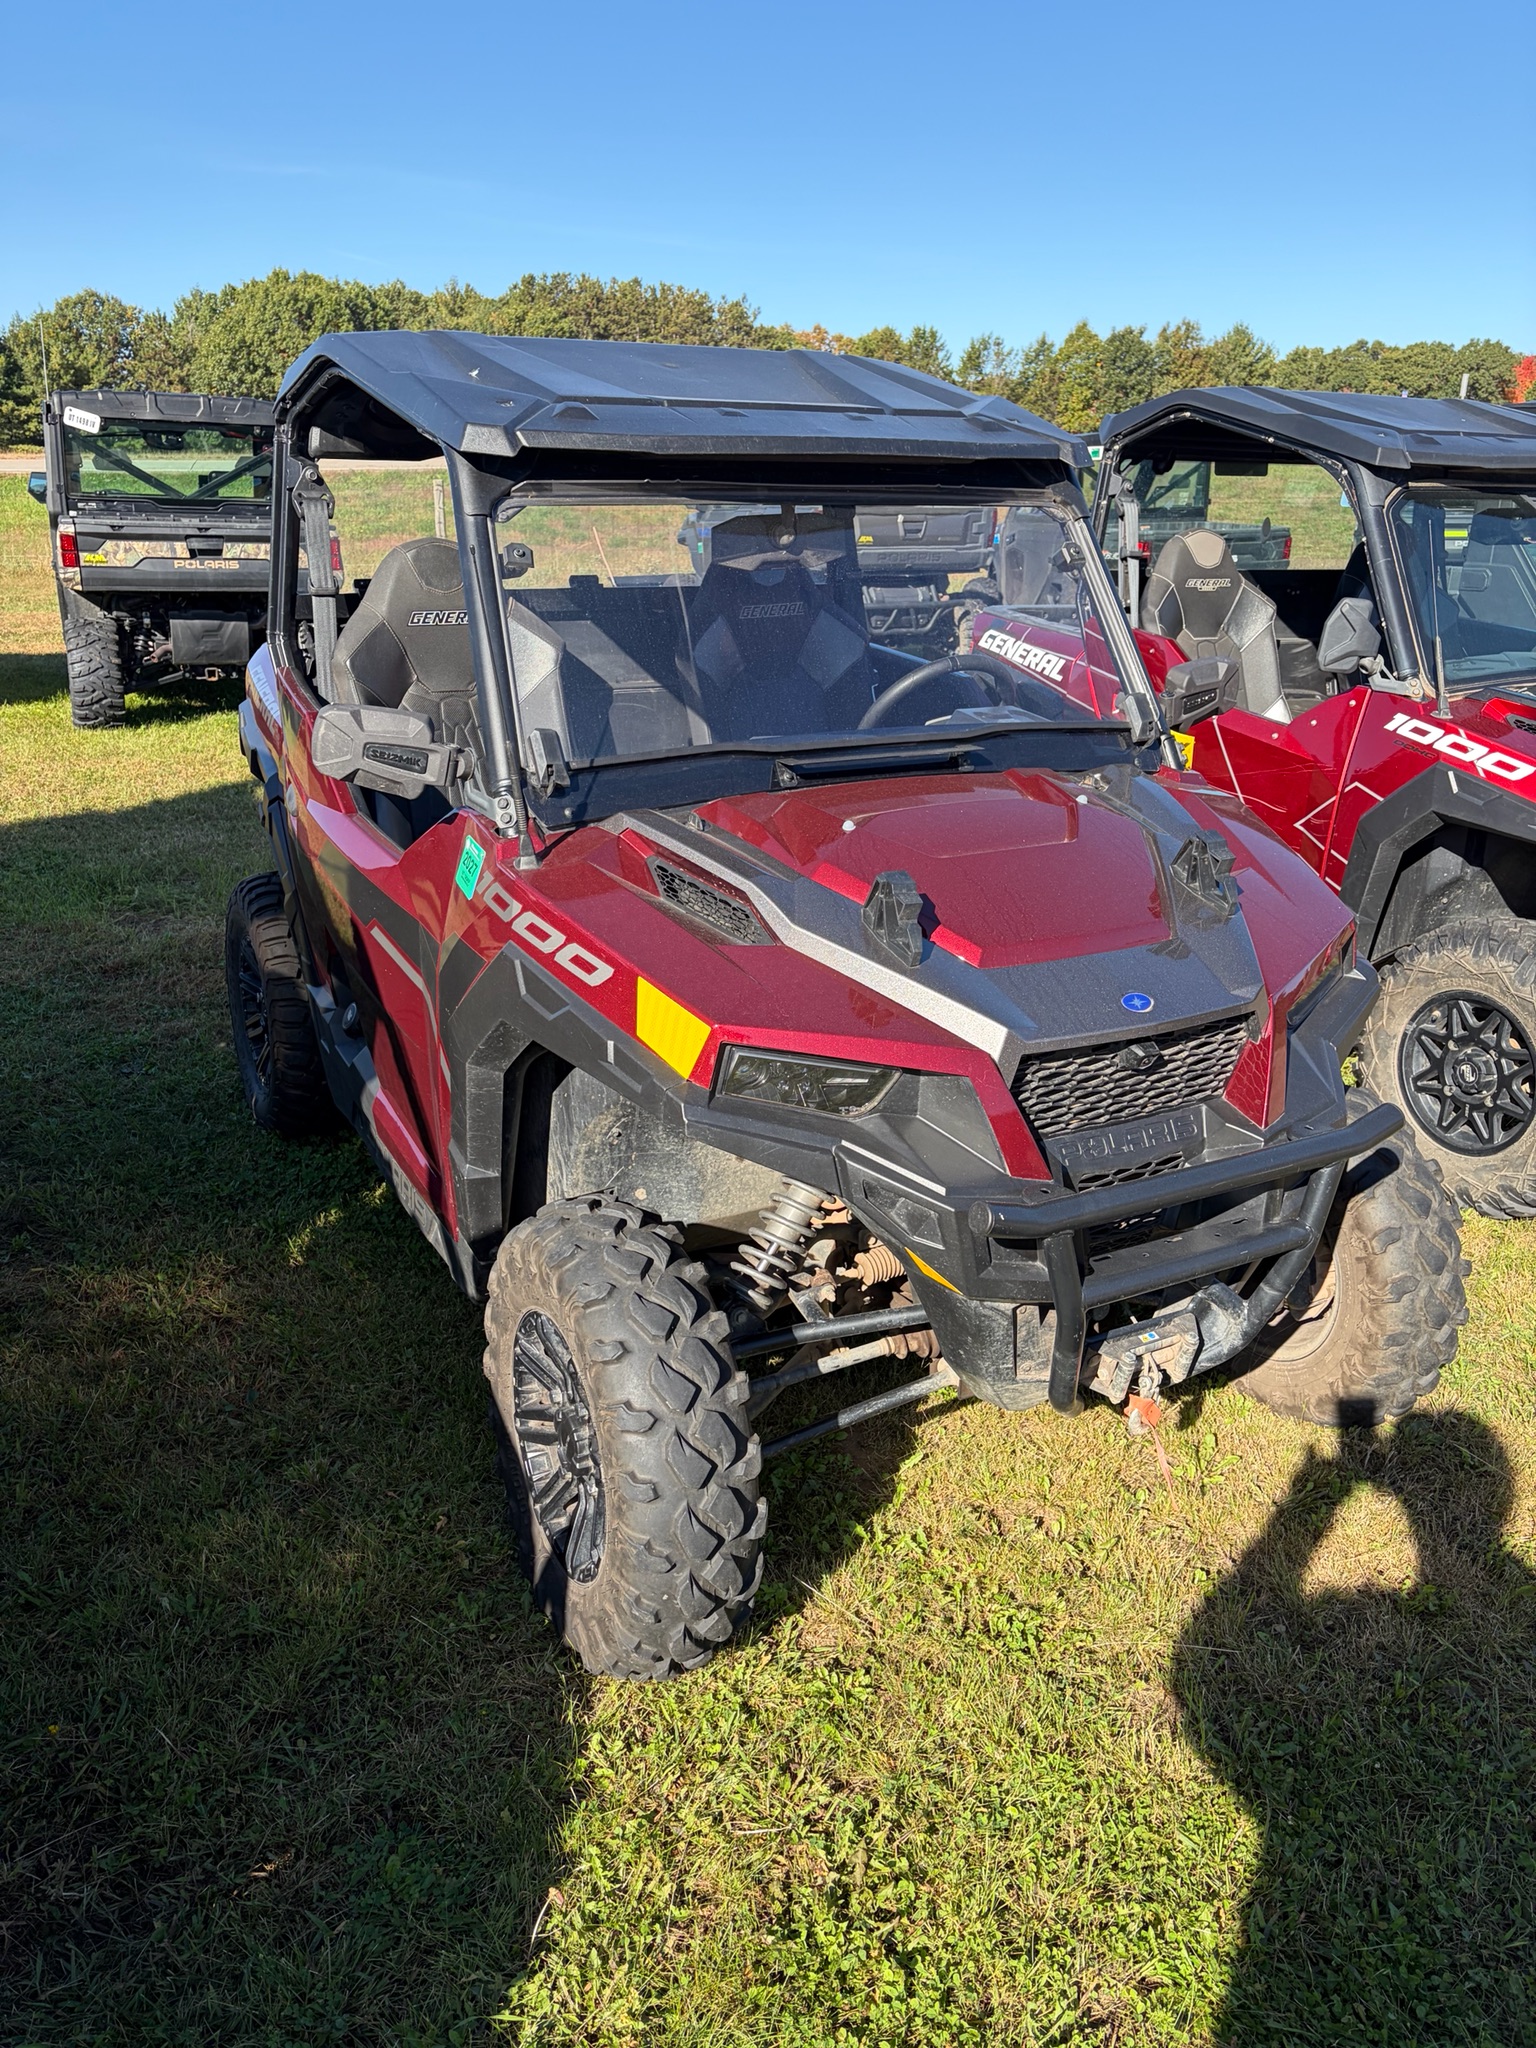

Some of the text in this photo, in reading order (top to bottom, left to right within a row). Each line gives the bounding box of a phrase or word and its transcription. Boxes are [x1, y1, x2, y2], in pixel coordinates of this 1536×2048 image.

[173, 559, 240, 570] POLARIS
[877, 552, 943, 564] POLARIS
[1184, 578, 1232, 588] GENERAL
[407, 610, 469, 626] GENER
[739, 601, 805, 620] GENERAL
[977, 628, 1067, 683] GENERAL
[1383, 712, 1536, 781] 1000
[1393, 739, 1436, 760] DOHC
[369, 748, 423, 768] SEIZMIK
[462, 851, 479, 878] 2027
[475, 870, 615, 988] 1000
[1056, 1113, 1199, 1168] POLARIS
